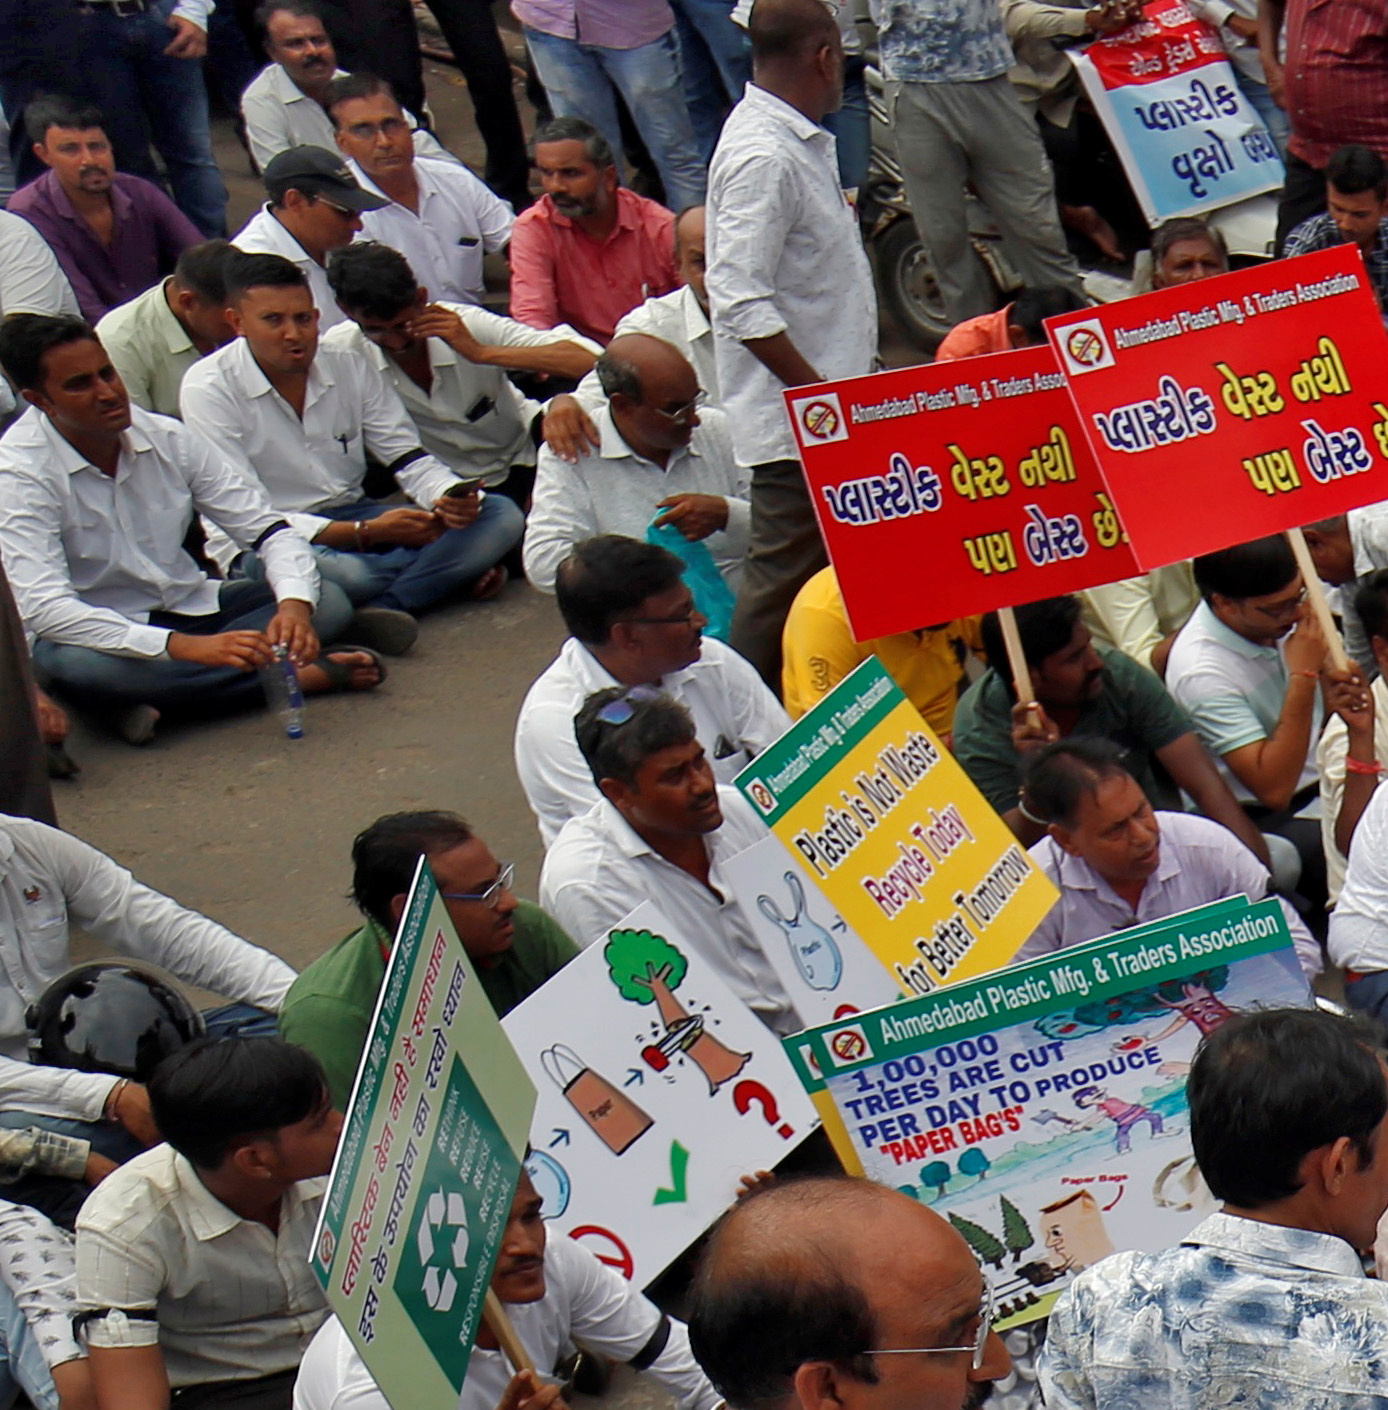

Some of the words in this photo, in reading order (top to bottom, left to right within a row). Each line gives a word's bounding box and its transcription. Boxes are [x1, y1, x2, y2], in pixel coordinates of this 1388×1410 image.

[856, 763, 904, 815] Not
[879, 733, 940, 790] Waste
[794, 807, 866, 877] Plastic
[841, 792, 877, 830] is
[864, 843, 933, 918] Recycle
[912, 803, 975, 863] Today
[896, 962, 937, 995] for
[917, 914, 976, 979] Better
[955, 845, 1033, 930] Tomorrow
[845, 1080, 940, 1116] TREES
[950, 1060, 1005, 1092] ARE
[1011, 1042, 1066, 1073] CUT
[853, 1035, 999, 1091] 1,00,000
[860, 1114, 922, 1148] PER
[926, 1094, 993, 1127] DAY
[990, 1082, 1032, 1109] TO
[1036, 1046, 1162, 1097] PRODUCE
[881, 1127, 958, 1166] "PAPER
[958, 1106, 1024, 1152] BAG'S"
